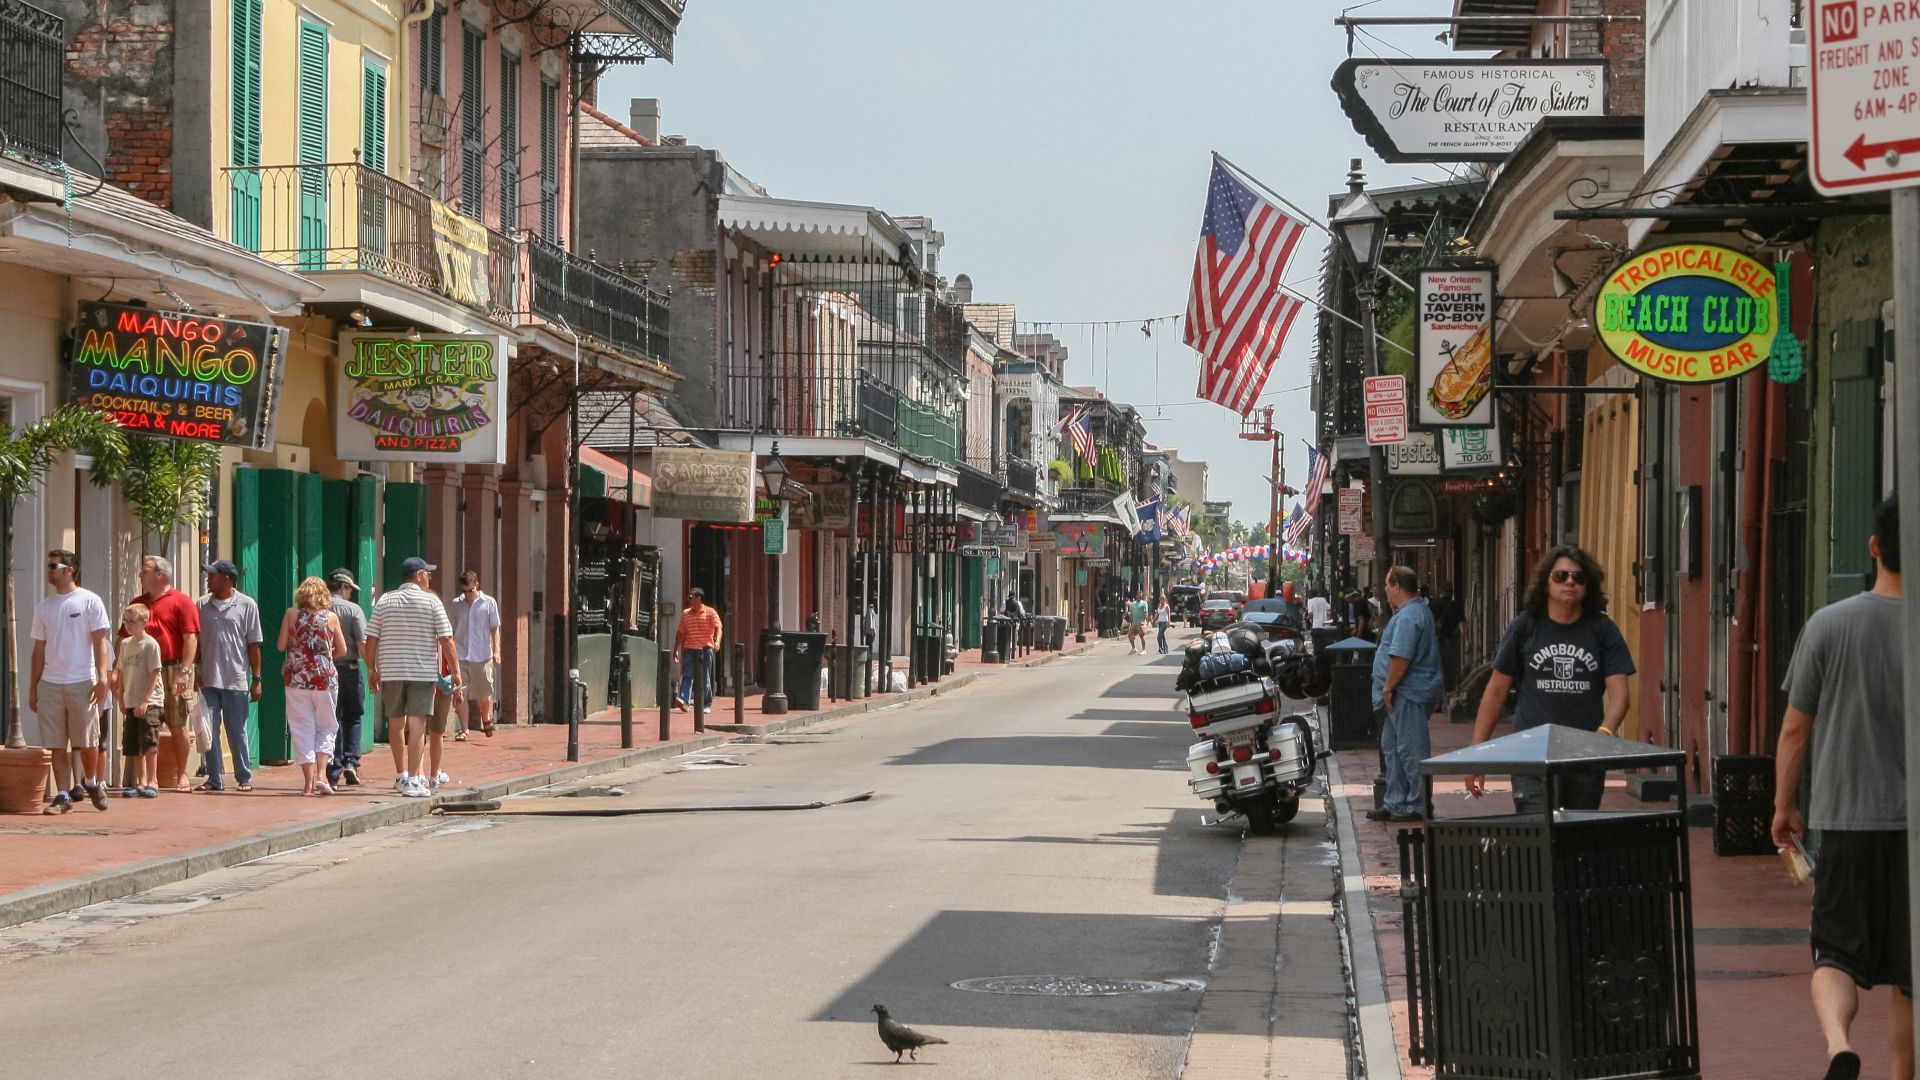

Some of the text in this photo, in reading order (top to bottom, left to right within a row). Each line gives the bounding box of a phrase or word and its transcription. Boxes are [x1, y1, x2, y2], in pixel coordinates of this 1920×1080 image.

[1825, 6, 1855, 37] NO
[1820, 44, 1870, 70] FREIGHT
[1878, 40, 1903, 62] AND
[1423, 69, 1556, 80] FAMOUS HISTORICAL
[1873, 66, 1909, 90] ZONE
[1389, 80, 1590, 120] The Court of Two Sisters
[1444, 122, 1536, 133] RESTAURANT
[1450, 275, 1482, 283] Orleans
[1613, 248, 1776, 298] TROPICAL ISLE
[1427, 293, 1482, 302] COURT
[1439, 284, 1472, 292] Famous
[1423, 313, 1485, 322] PO-BOY
[1424, 303, 1485, 312] TAVERN
[1604, 294, 1770, 335] BEACH CLUB
[117, 312, 223, 343] MANGO
[1431, 323, 1479, 331] Sandwiches
[79, 329, 257, 385] MANGO
[345, 338, 497, 381] JESTER
[1625, 338, 1758, 377] MUSIC BAR
[89, 368, 243, 406] DAIQUIRIS
[384, 375, 460, 390] MARDI GRAS
[1376, 380, 1401, 390] PARKING
[92, 394, 233, 421] COCKTAILS & BEER
[350, 402, 489, 436] DAIQUIRIS
[1368, 405, 1402, 416] NO PARKING
[154, 414, 166, 429] &
[170, 420, 222, 439] MORE
[376, 437, 458, 449] AND PIZZA
[1475, 453, 1492, 461] GO!
[1529, 644, 1599, 672] LONGBOARD
[1536, 680, 1591, 690] INSTRUCTOR
